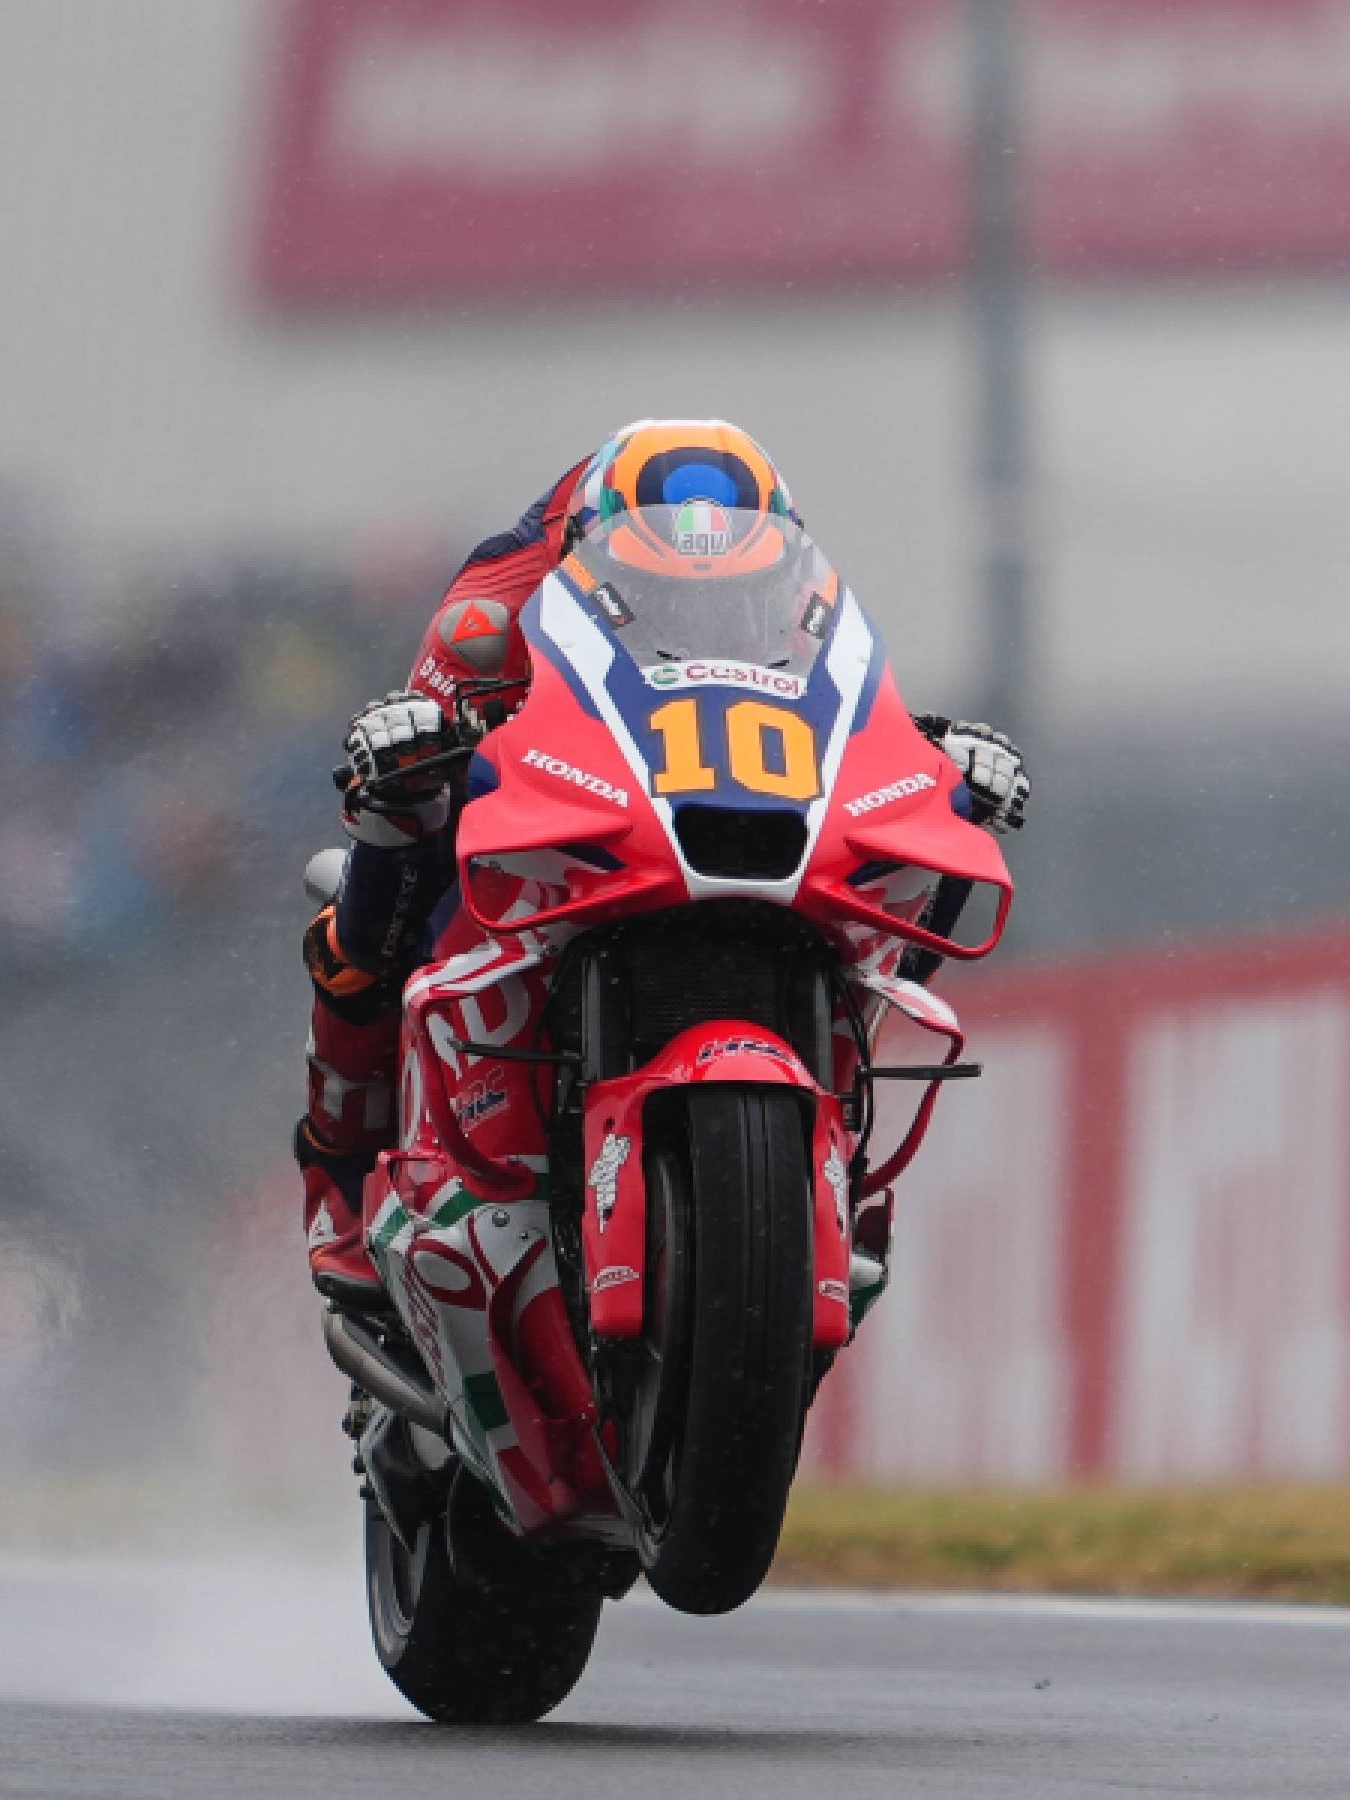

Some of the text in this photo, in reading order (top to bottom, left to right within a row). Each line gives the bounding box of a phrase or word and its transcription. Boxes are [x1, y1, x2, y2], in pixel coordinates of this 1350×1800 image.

[677, 531, 728, 556] agv
[685, 664, 799, 697] Castrol
[649, 698, 820, 799] 10
[521, 749, 628, 808] HONDA
[843, 773, 937, 817] HONDA
